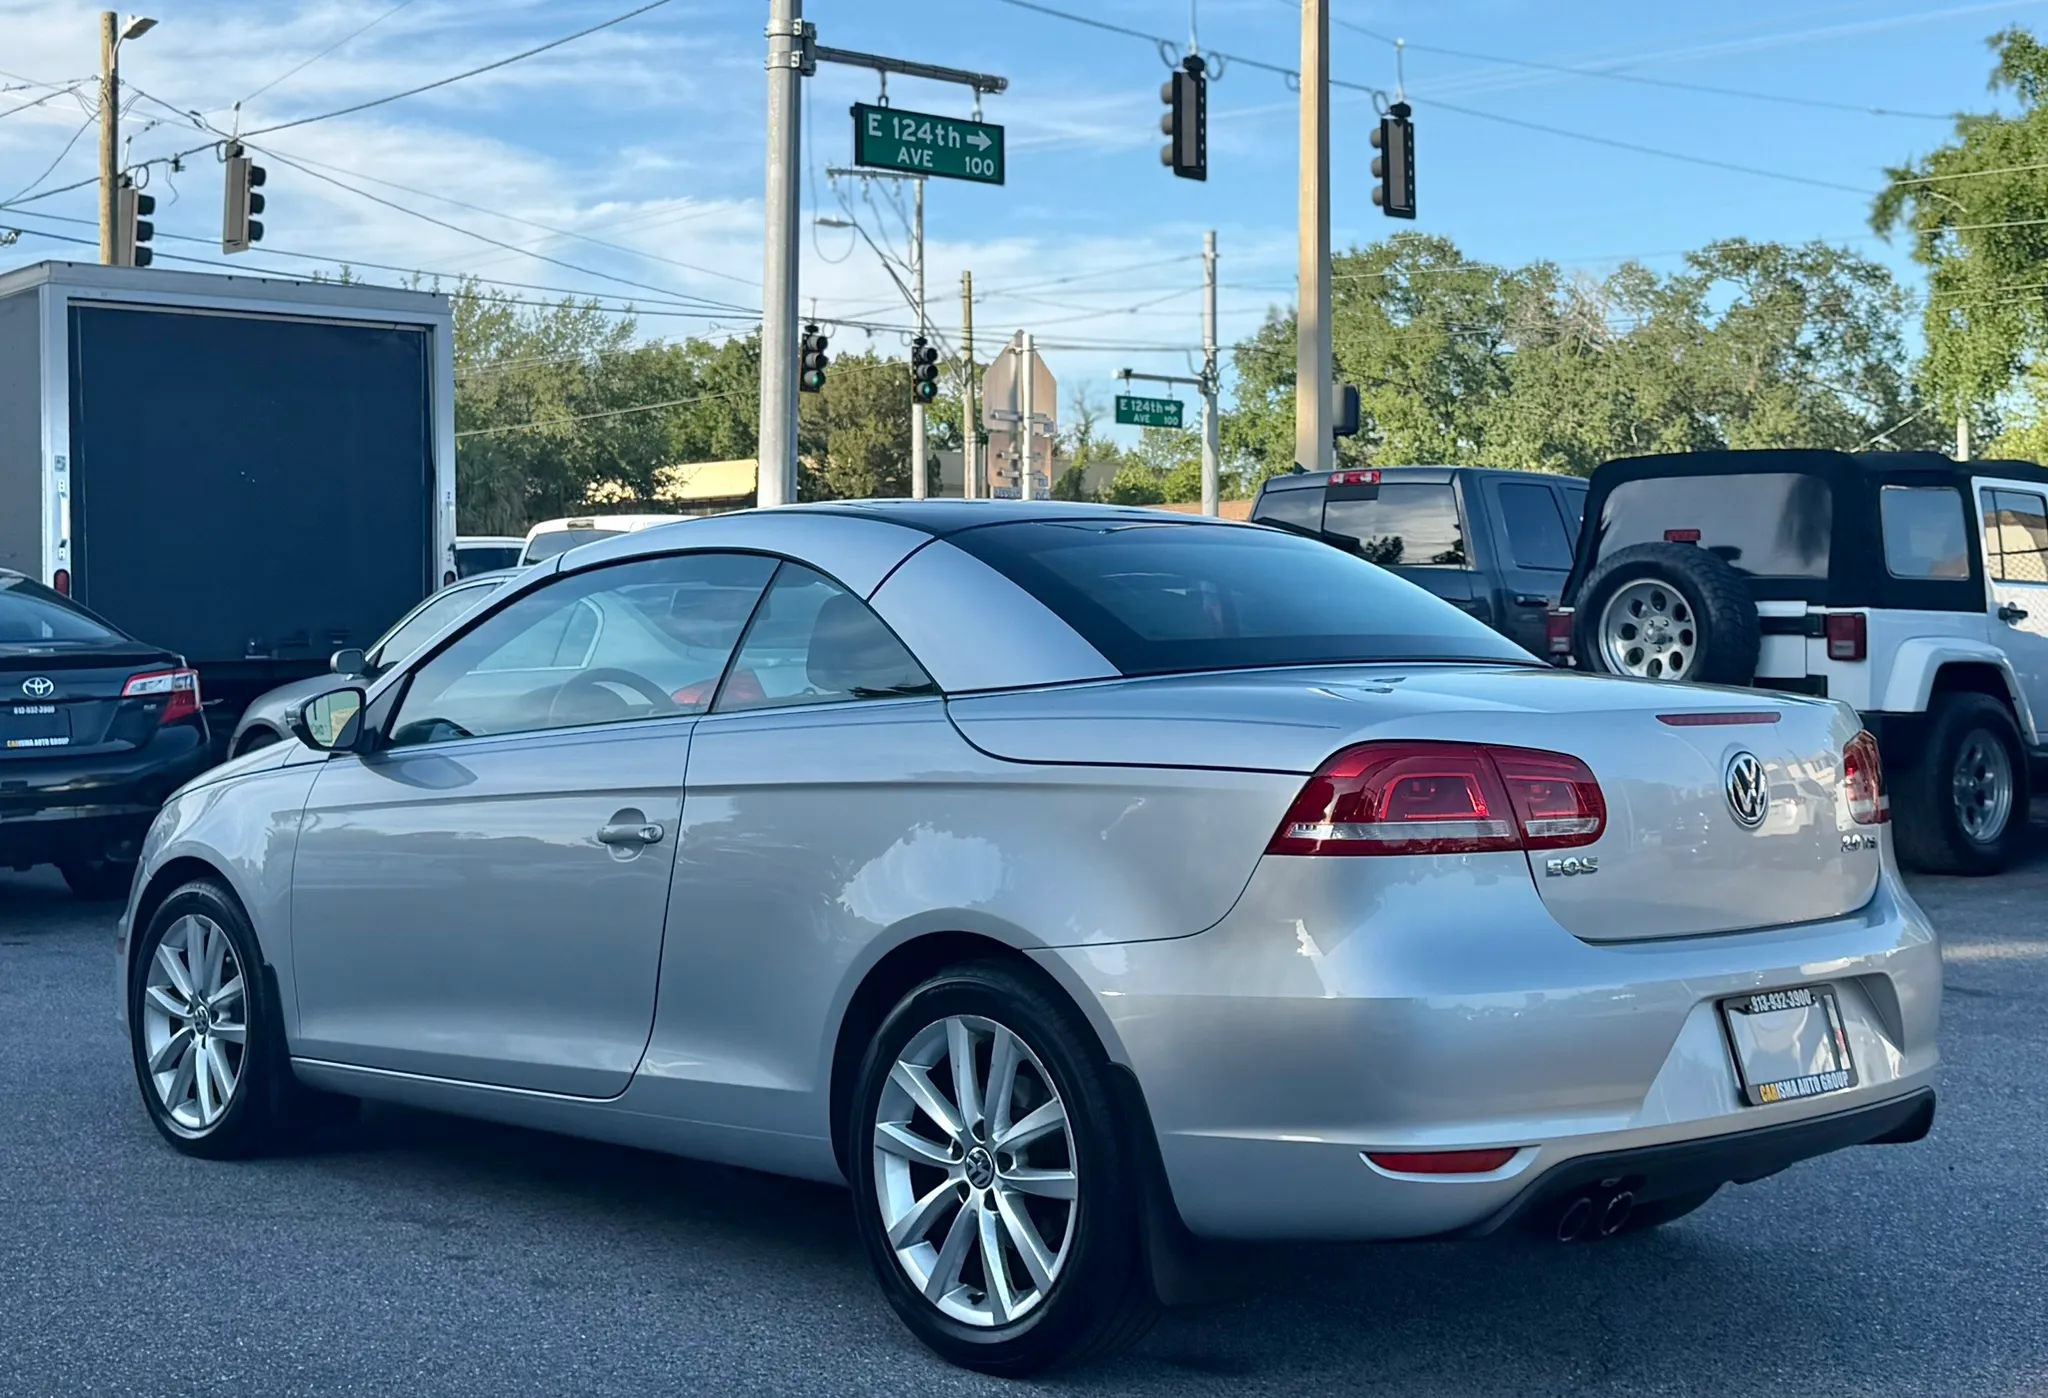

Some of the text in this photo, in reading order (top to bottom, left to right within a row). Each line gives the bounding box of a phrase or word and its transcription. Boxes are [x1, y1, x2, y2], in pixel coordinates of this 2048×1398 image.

[868, 113, 961, 149] E 124th
[897, 146, 934, 168] AVE
[965, 156, 994, 176] 100
[1120, 399, 1163, 414] E 124th
[1133, 414, 1151, 424] AVE
[1163, 416, 1179, 426] 100
[1545, 856, 1599, 877] EOS
[1760, 1071, 1848, 1102] CARISMA AUTO GROUP
